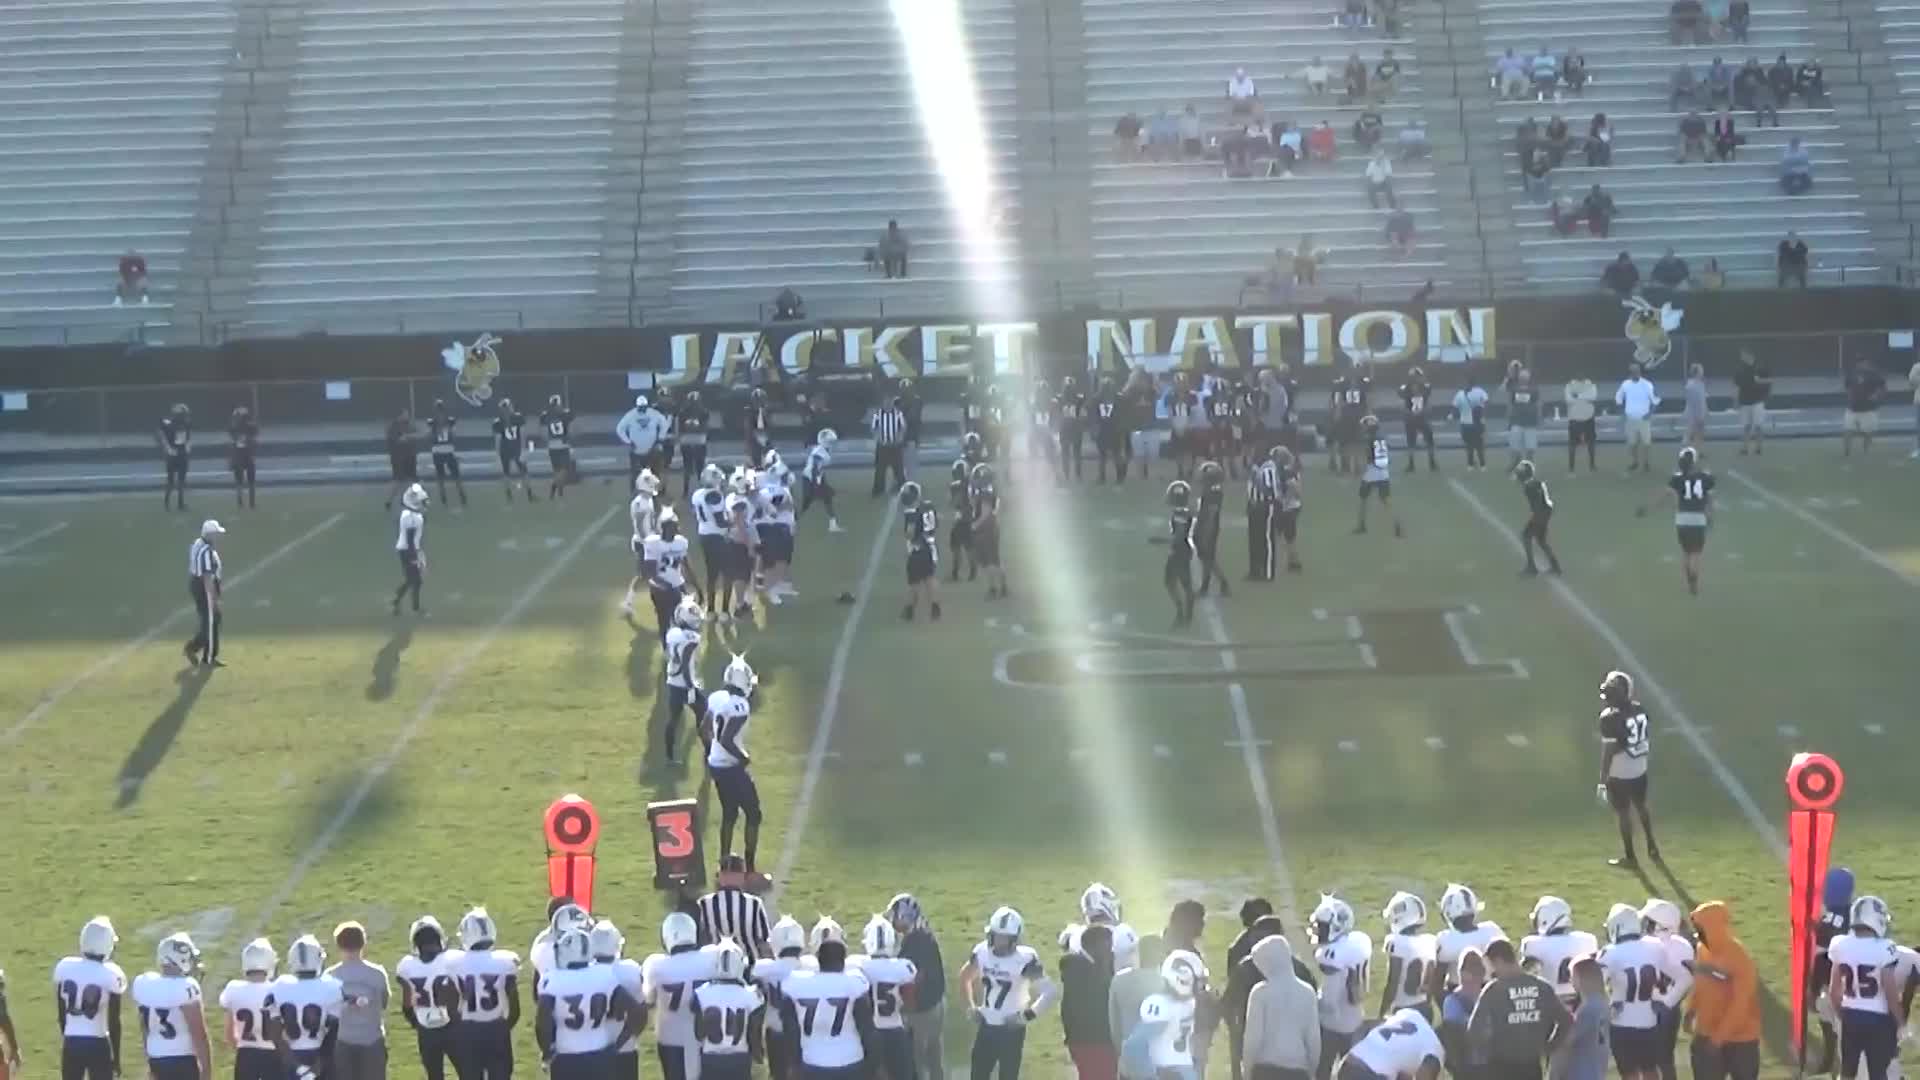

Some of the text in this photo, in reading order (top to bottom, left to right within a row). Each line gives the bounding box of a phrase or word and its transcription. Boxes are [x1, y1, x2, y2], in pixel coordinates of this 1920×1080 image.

[655, 307, 1497, 387] JACKET NATION
[1626, 713, 1648, 744] 37
[655, 811, 695, 858] 3
[797, 997, 850, 1037] 77
